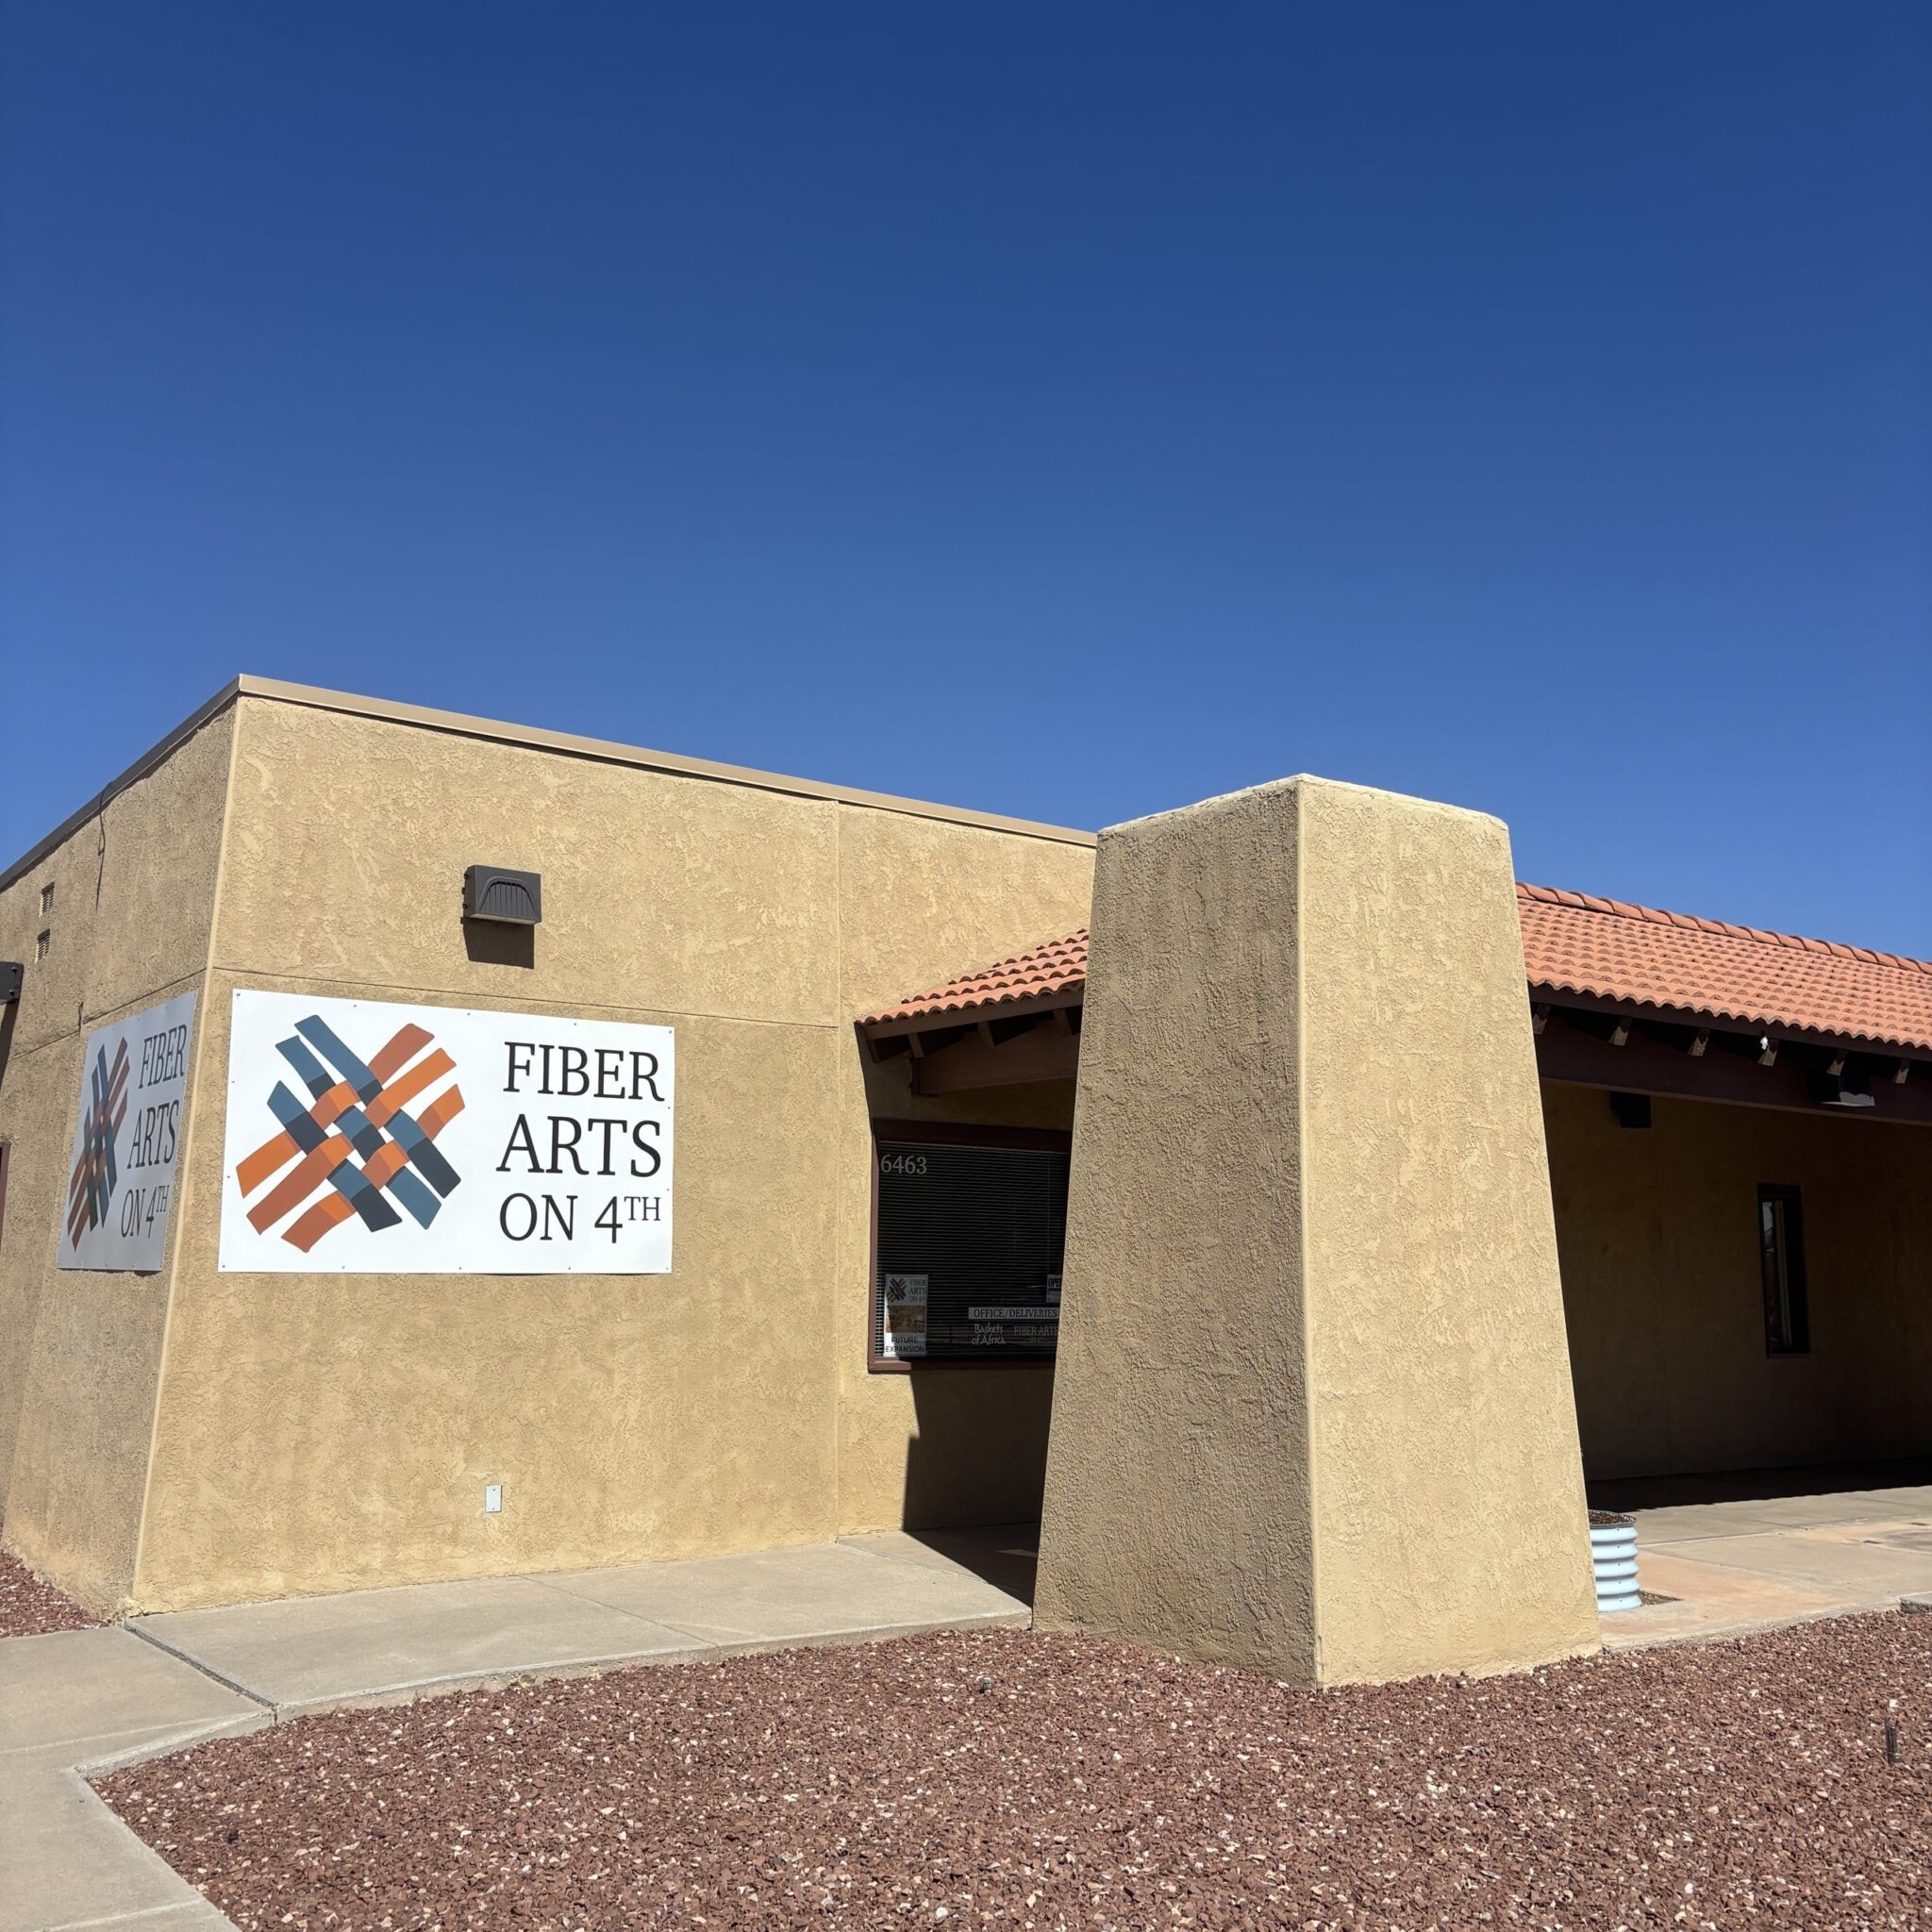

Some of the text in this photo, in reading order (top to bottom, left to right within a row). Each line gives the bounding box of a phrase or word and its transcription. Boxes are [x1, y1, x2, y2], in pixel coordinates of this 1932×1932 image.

[138, 1024, 187, 1090] FIBER
[503, 1041, 665, 1102] FIBER
[126, 1100, 179, 1170] ARTS
[495, 1113, 661, 1177] ARTS
[880, 1154, 927, 1174] 6463
[121, 1185, 170, 1239] ON 4TH
[499, 1192, 661, 1243] ON 4TH
[1048, 1277, 1061, 1288] OPE
[891, 1336, 920, 1344] FUTURE
